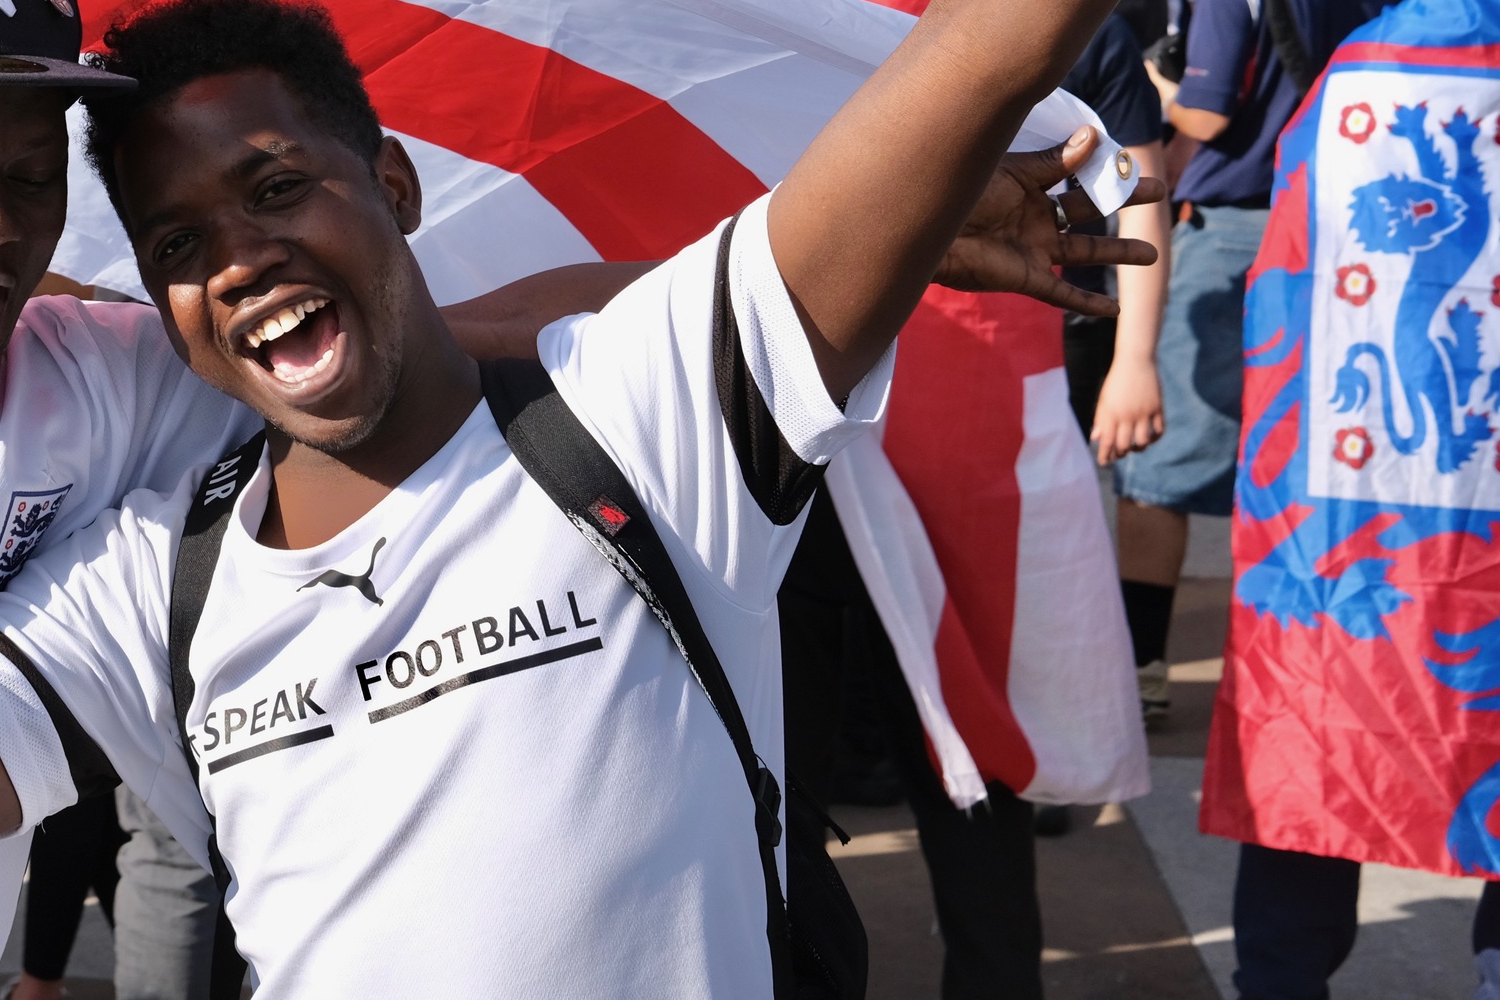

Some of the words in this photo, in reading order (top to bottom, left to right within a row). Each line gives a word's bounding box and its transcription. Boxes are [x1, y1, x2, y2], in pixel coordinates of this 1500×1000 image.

[204, 455, 242, 506] AIR
[203, 678, 327, 751] SPEAK
[356, 591, 597, 701] FOOTBALL
